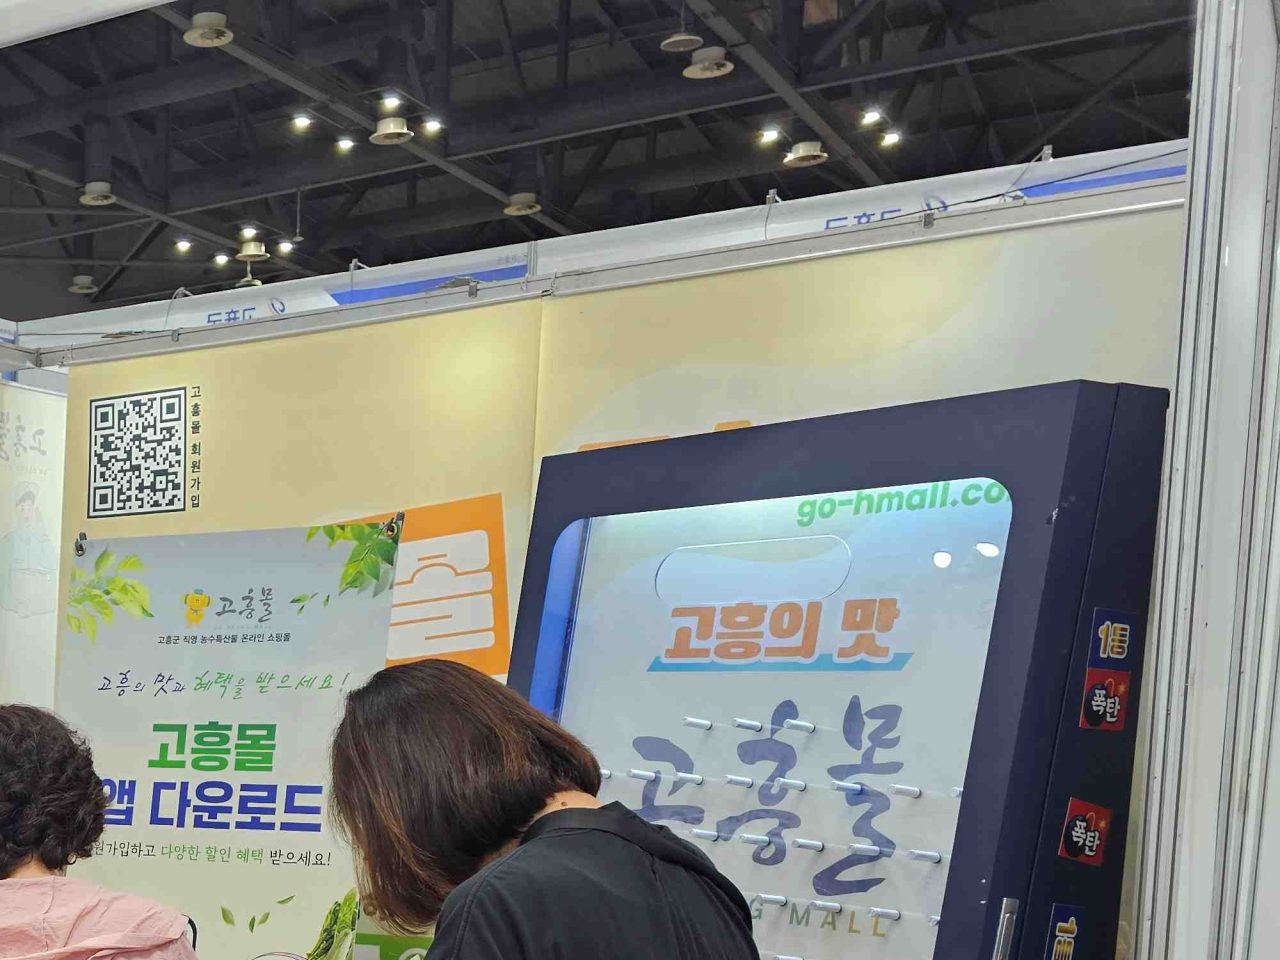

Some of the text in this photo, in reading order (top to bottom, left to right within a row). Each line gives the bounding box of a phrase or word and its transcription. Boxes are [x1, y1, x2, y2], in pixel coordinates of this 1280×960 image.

[191, 386, 201, 508] 고흥몰 회원가입
[796, 480, 1010, 527] go-hmall.co
[216, 586, 273, 623] 고흥몰
[158, 635, 180, 645] 고흥군
[183, 635, 198, 644] 직영
[241, 633, 265, 643] 온라인
[267, 632, 291, 643] 쇼핑몰
[664, 597, 901, 662] 고흥의 맛
[1098, 621, 1130, 658] 1등
[97, 669, 352, 700] 고흥의 맛과 혜택을 받으세요!
[1092, 688, 1120, 722] 폭탄
[148, 721, 277, 772] 고흥몰
[101, 778, 323, 832] 앱 다운로드
[632, 694, 904, 896] 고흥몰
[93, 840, 331, 868] 원가입하고 다양한 할인 혜택 받으세요!
[1072, 819, 1100, 856] 폭탄
[789, 907, 887, 938] MALL
